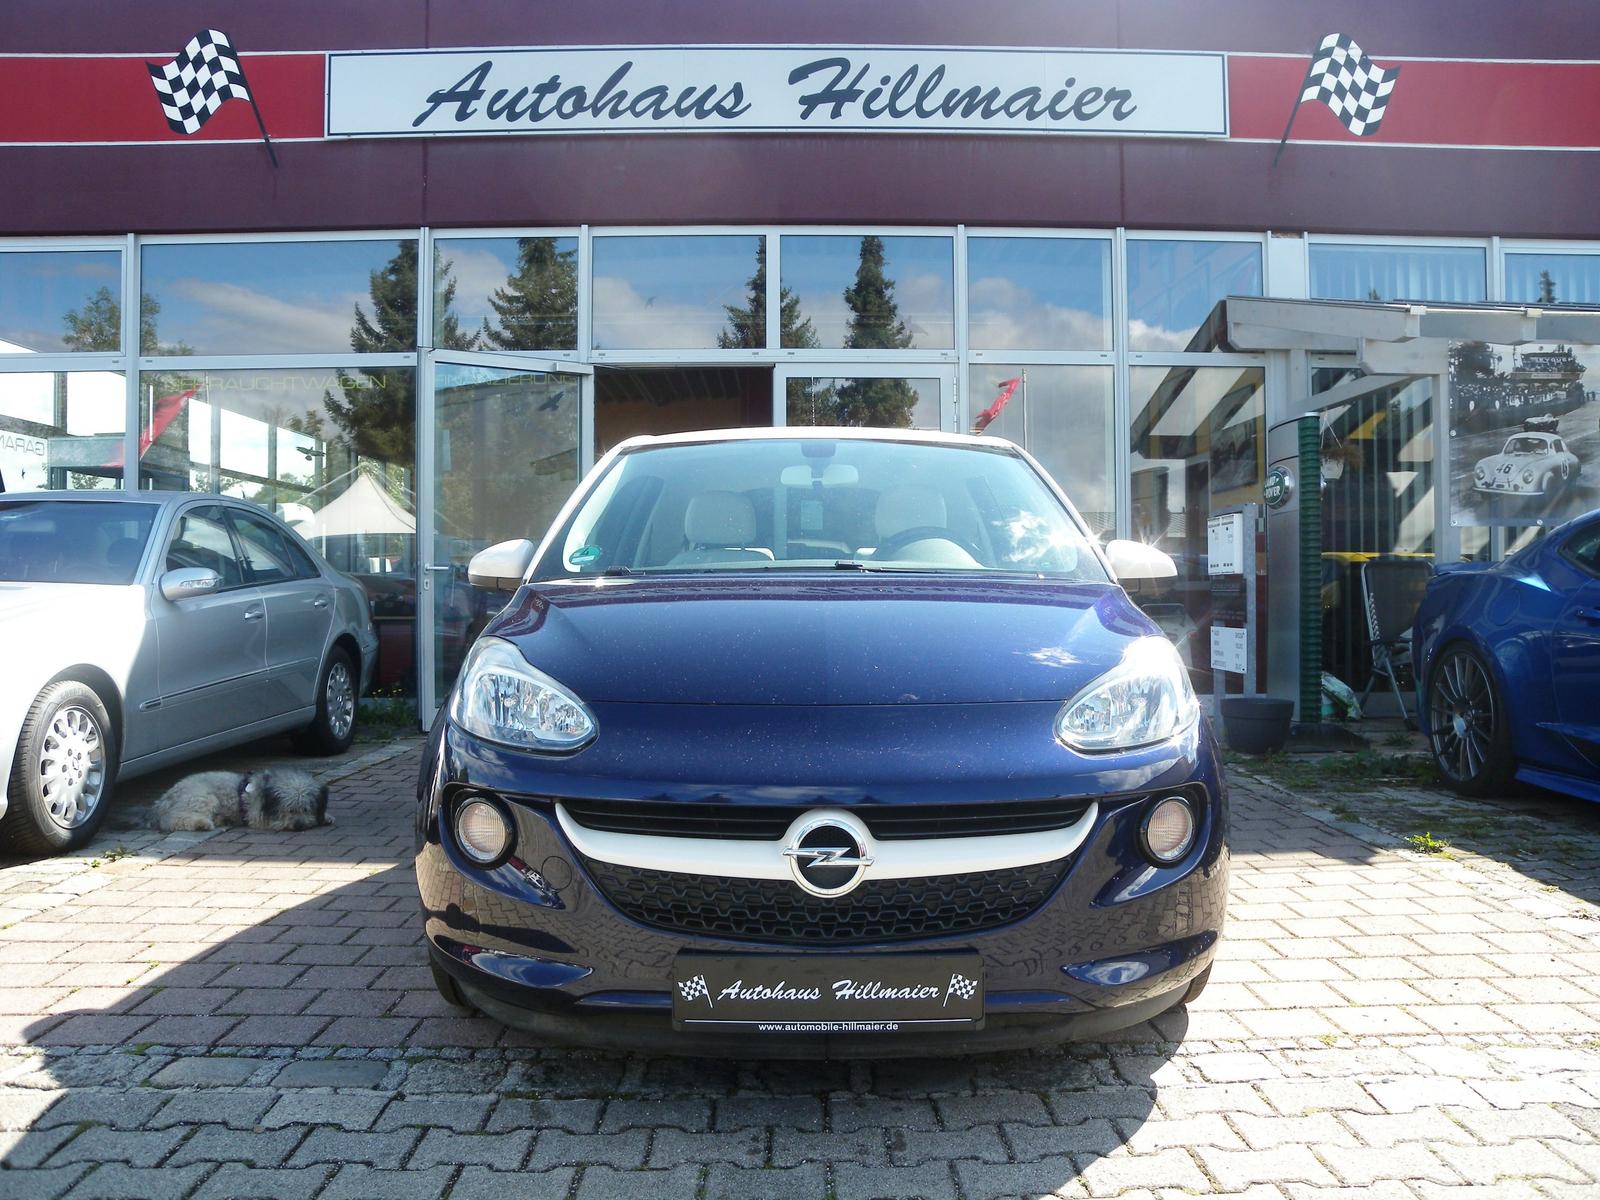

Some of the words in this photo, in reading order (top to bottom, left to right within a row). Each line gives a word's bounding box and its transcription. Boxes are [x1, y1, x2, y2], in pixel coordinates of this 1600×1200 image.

[412, 60, 751, 127] Autohaus
[788, 57, 1137, 121] Hillmaier
[1495, 463, 1513, 474] 46
[717, 979, 821, 1001] Autohaus
[831, 979, 940, 1000] Hillmaier
[758, 1022, 899, 1032] www.automobile-hillmaier.de
